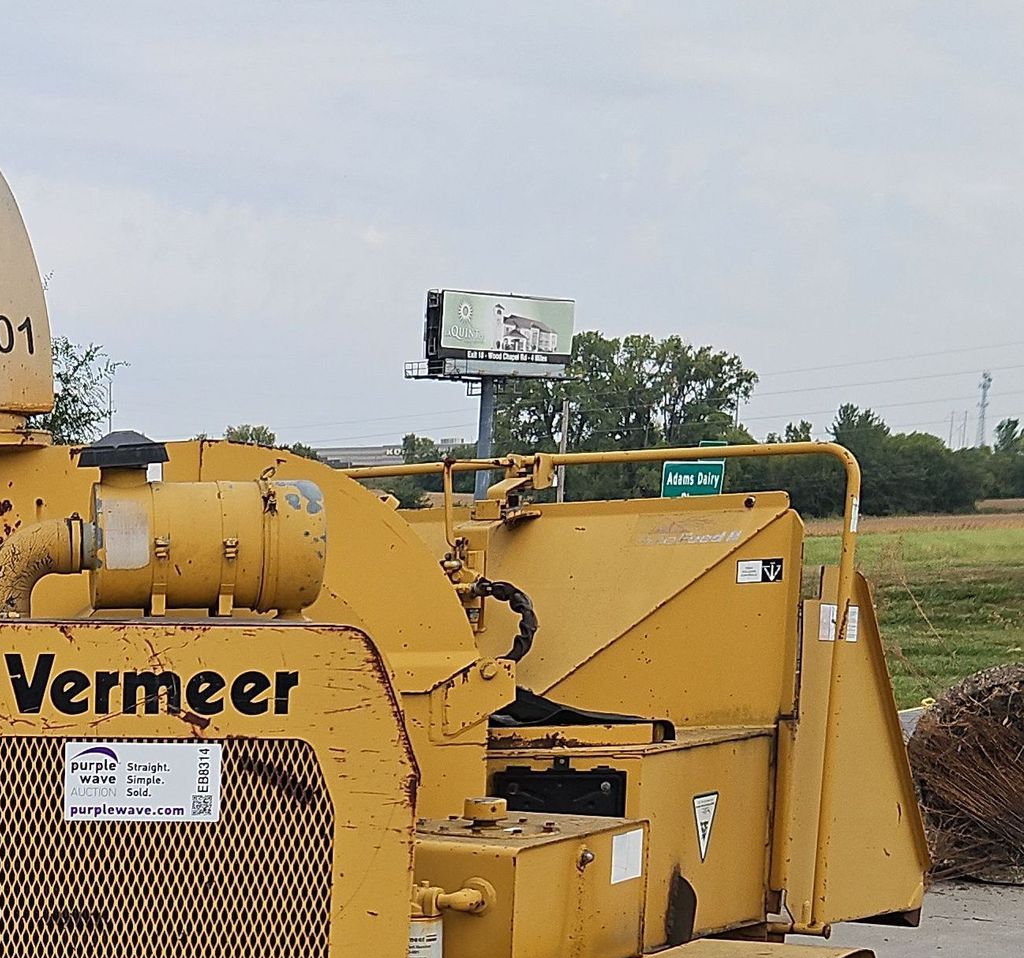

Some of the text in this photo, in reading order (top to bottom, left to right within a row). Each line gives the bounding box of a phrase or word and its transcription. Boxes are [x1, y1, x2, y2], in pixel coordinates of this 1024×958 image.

[666, 472, 720, 488] Adams Dairy
[4, 653, 299, 716] Vermeer
[70, 760, 117, 774] purple
[127, 762, 171, 774] Straight.
[197, 748, 210, 793] EB8314
[80, 774, 117, 785] wave
[127, 775, 165, 786] Simple.
[70, 787, 117, 797] AUCTION
[126, 787, 152, 797] Sold.
[70, 804, 185, 817] purplewave.com
